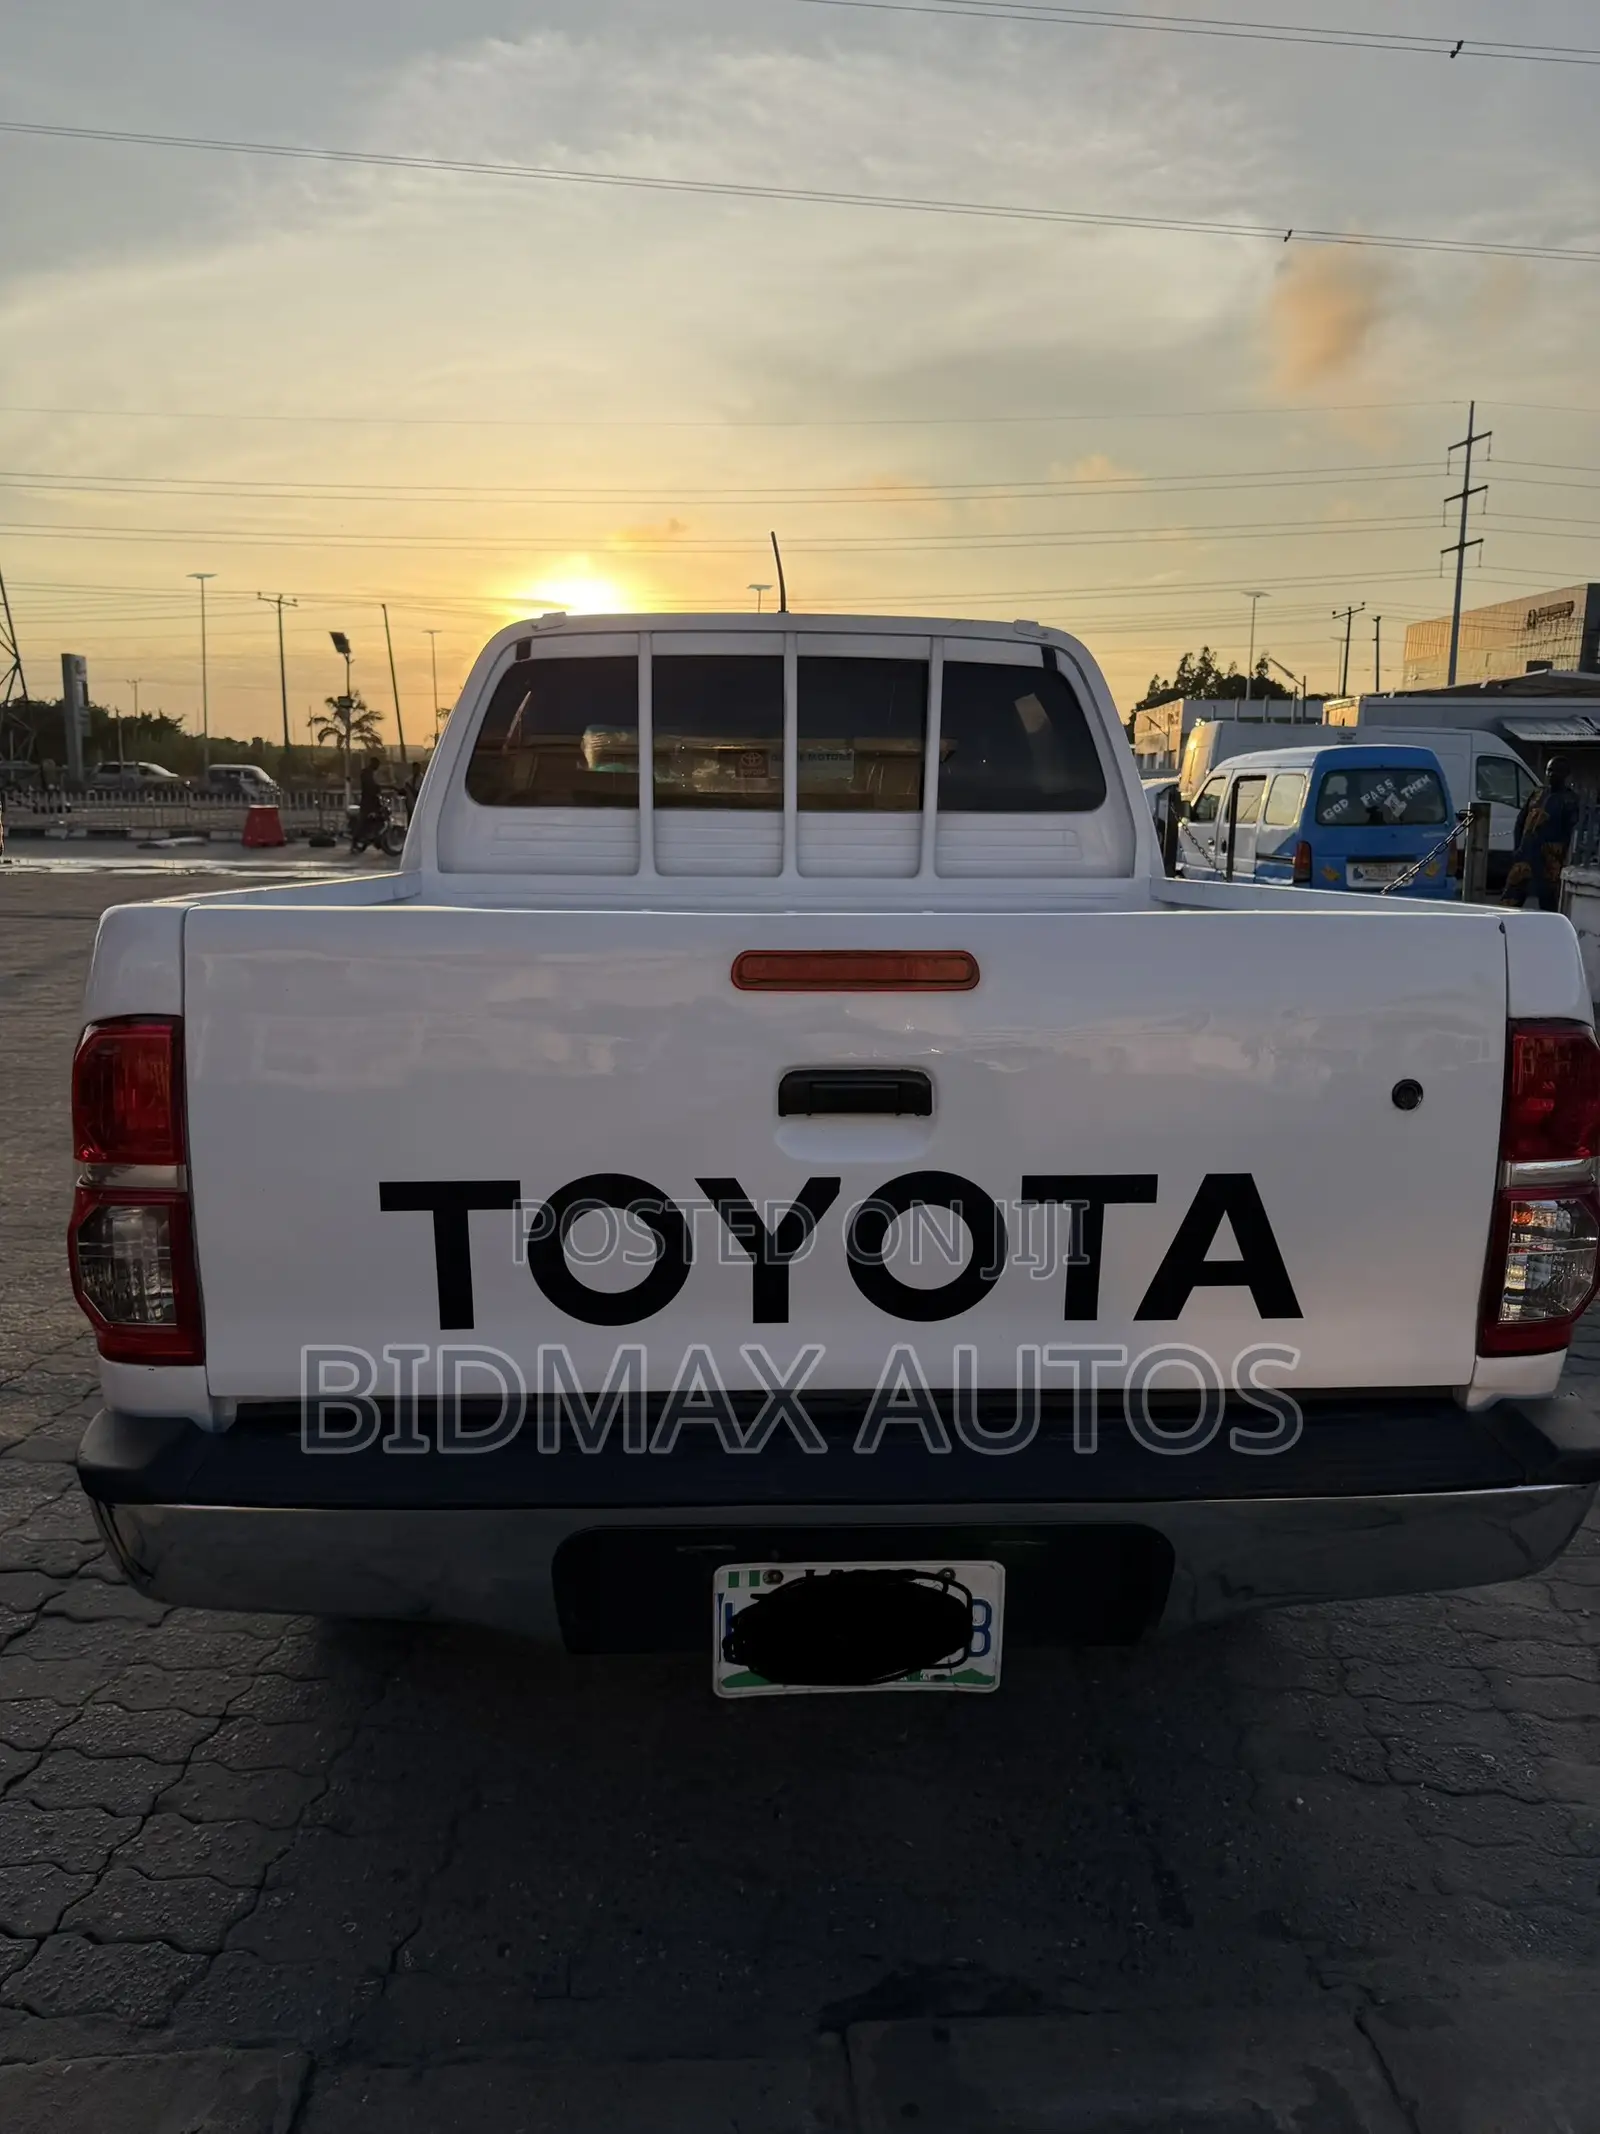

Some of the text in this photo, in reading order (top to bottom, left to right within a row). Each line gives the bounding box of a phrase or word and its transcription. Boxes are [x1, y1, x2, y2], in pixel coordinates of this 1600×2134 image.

[1322, 774, 1431, 820] GOD PASS THEM
[379, 1170, 1304, 1330] TOYOTA
